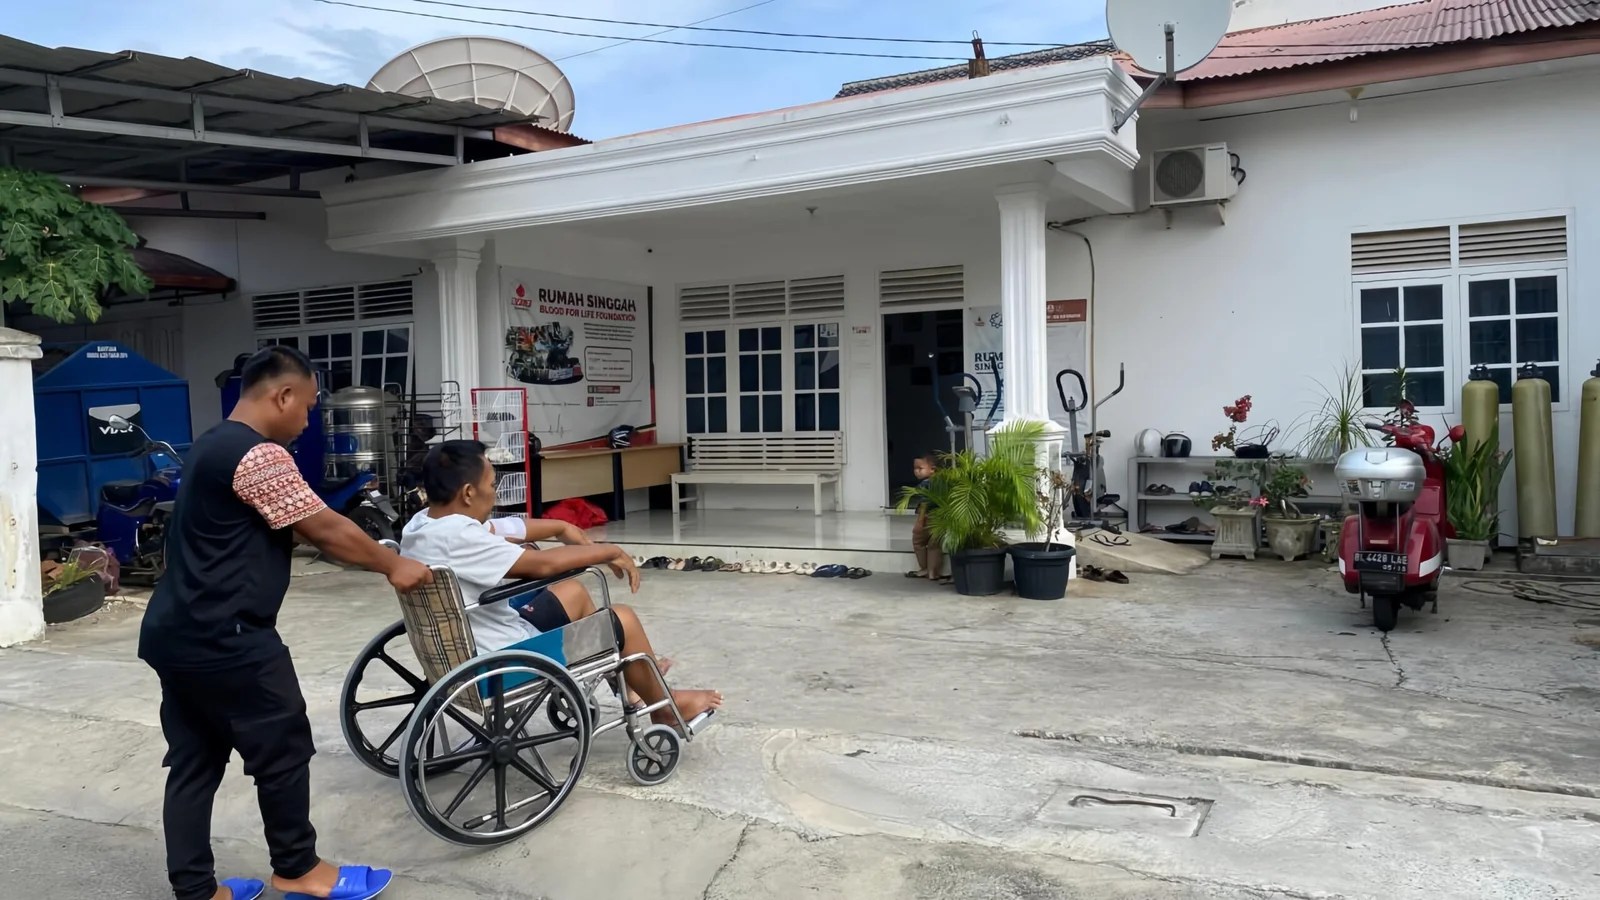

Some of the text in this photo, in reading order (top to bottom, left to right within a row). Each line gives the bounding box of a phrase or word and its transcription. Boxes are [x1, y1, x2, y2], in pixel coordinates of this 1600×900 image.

[539, 288, 584, 306] RUMAH
[587, 295, 636, 312] SINGGAH
[539, 305, 564, 316] BLOOD
[565, 308, 580, 317] FOR
[580, 309, 594, 319] LIFE
[974, 362, 1004, 370] SING
